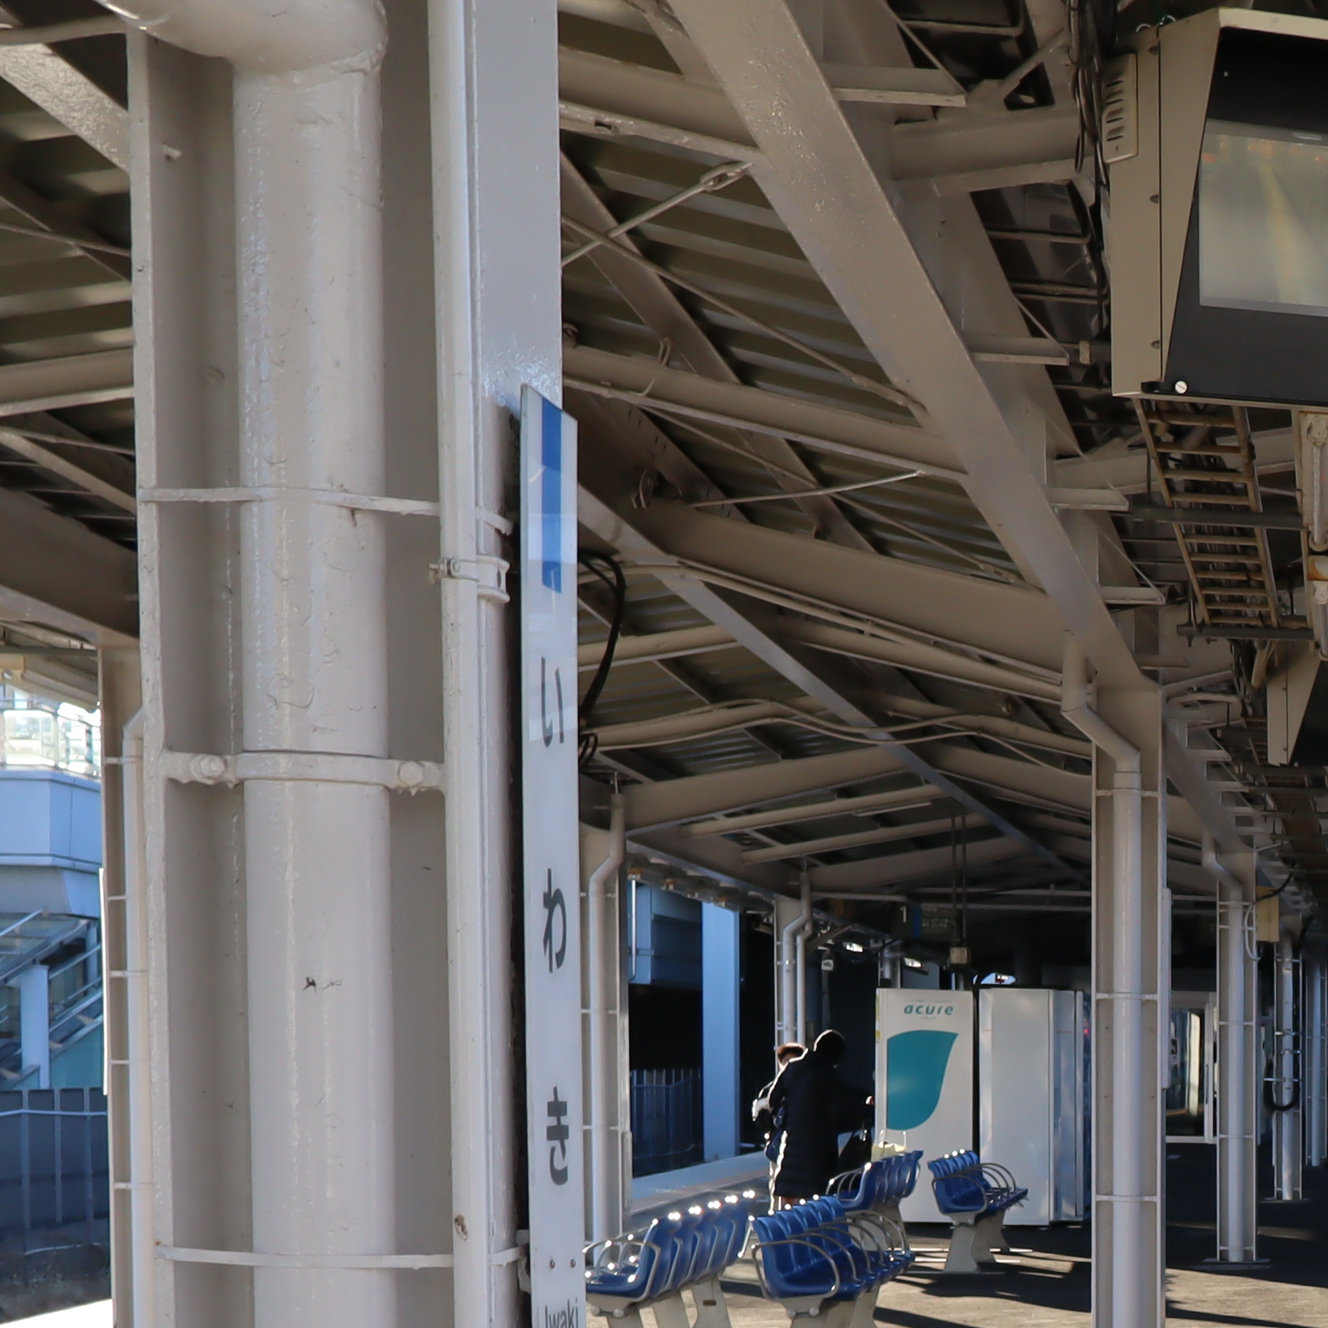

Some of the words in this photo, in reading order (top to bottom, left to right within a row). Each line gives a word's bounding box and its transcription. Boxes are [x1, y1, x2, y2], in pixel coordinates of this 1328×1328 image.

[541, 656, 570, 1186] いわき
[903, 1004, 954, 1016] acure
